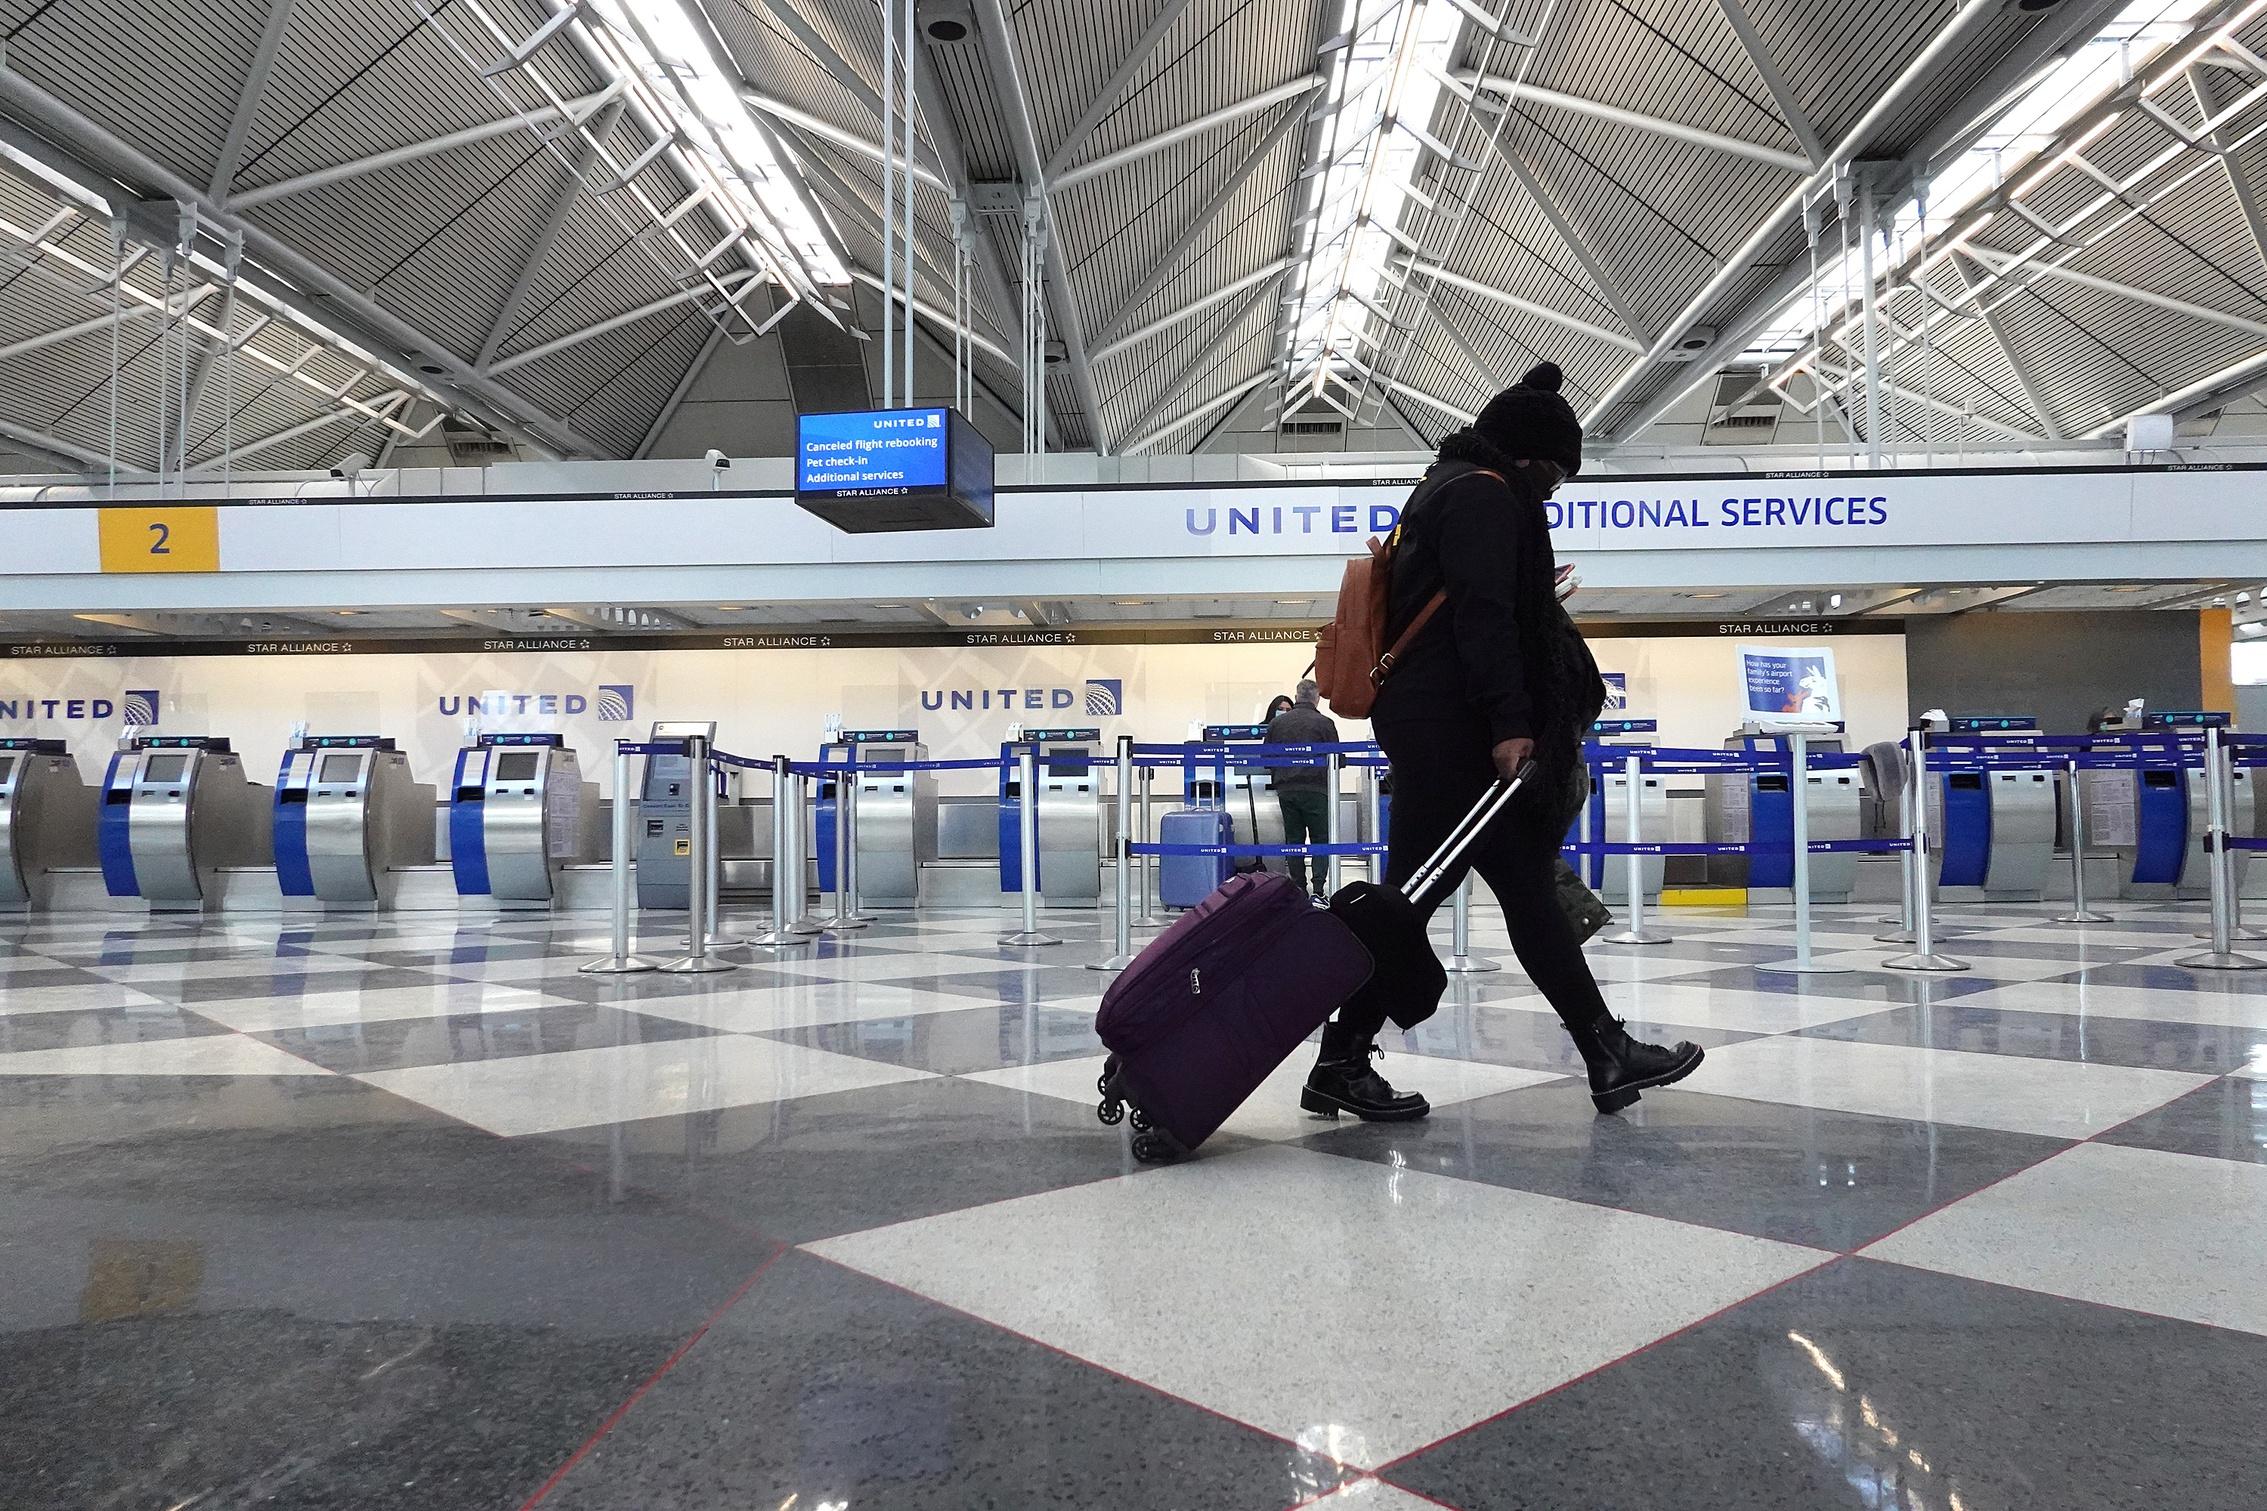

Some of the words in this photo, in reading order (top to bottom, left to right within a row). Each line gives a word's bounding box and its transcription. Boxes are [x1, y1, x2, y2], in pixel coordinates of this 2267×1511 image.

[873, 418, 924, 429] UNITED
[806, 441, 853, 452] Canceled
[855, 439, 883, 452] flight
[885, 437, 938, 448] rebooking
[806, 458, 823, 467] Pet
[825, 456, 868, 467] check-in
[806, 471, 860, 483] Additional
[862, 470, 904, 481] services
[836, 489, 857, 497] STAR
[858, 488, 899, 497] ALLIANCE
[1720, 496, 1888, 527] SERVICES
[1186, 505, 1400, 537] UNITED
[149, 523, 170, 554] 2
[1719, 624, 1752, 634] STAR
[1755, 623, 1818, 633] ALLIANCE
[966, 634, 998, 644] STAR
[1000, 633, 1062, 643] ALLIANCE
[1213, 631, 1245, 641] STAR
[1248, 630, 1310, 640] ALLIANCE
[484, 640, 514, 650] STAR
[516, 639, 576, 649] ALLIANCE
[723, 637, 754, 647] STAR
[757, 636, 817, 646] ALLIANCE
[11, 645, 42, 655] STAR
[44, 645, 104, 655] ALLIANCE
[247, 643, 277, 653] STAR
[280, 642, 339, 652] ALLIANCE
[1770, 669, 1793, 677] airport
[439, 694, 587, 716] UNITED
[921, 688, 1074, 711] UNITED
